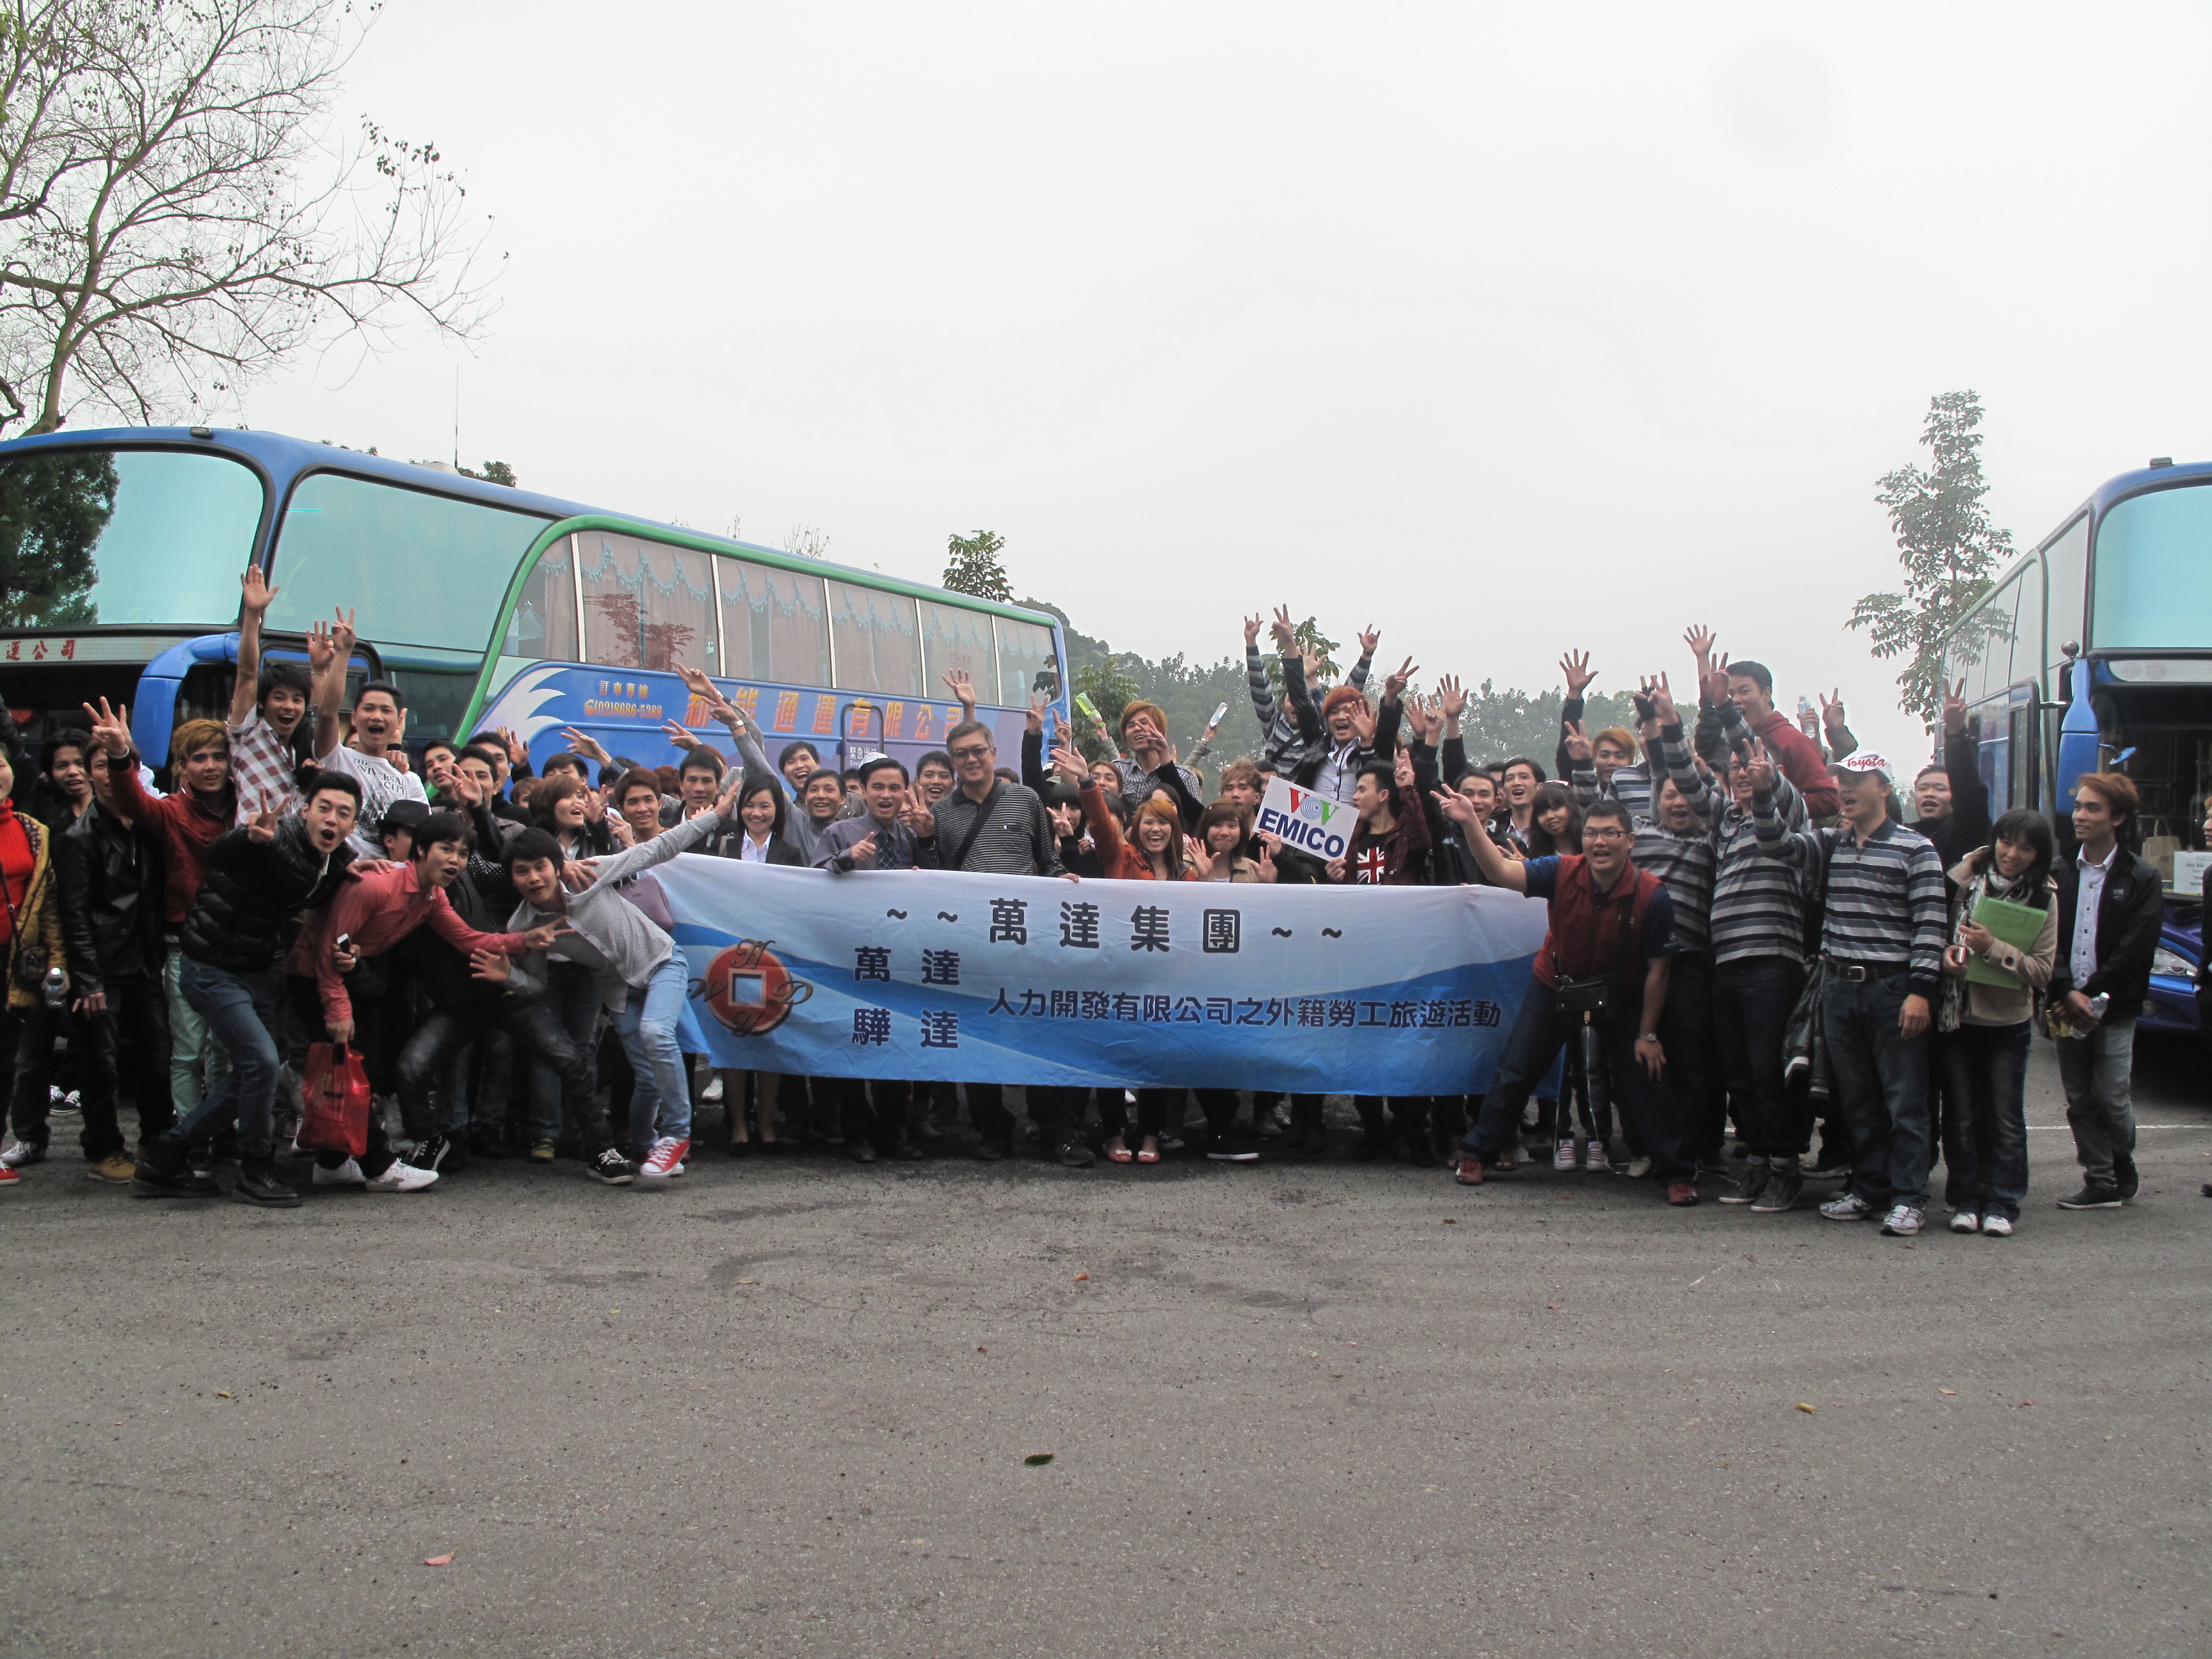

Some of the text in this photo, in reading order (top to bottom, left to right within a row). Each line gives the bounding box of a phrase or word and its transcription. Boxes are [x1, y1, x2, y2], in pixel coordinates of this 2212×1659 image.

[1840, 757, 1887, 771] Toyota
[1258, 808, 1344, 858] EMICO
[854, 946, 960, 985] 萬達
[988, 988, 1501, 1028] 人力開發有限公司之外籍勞工旅遊活動
